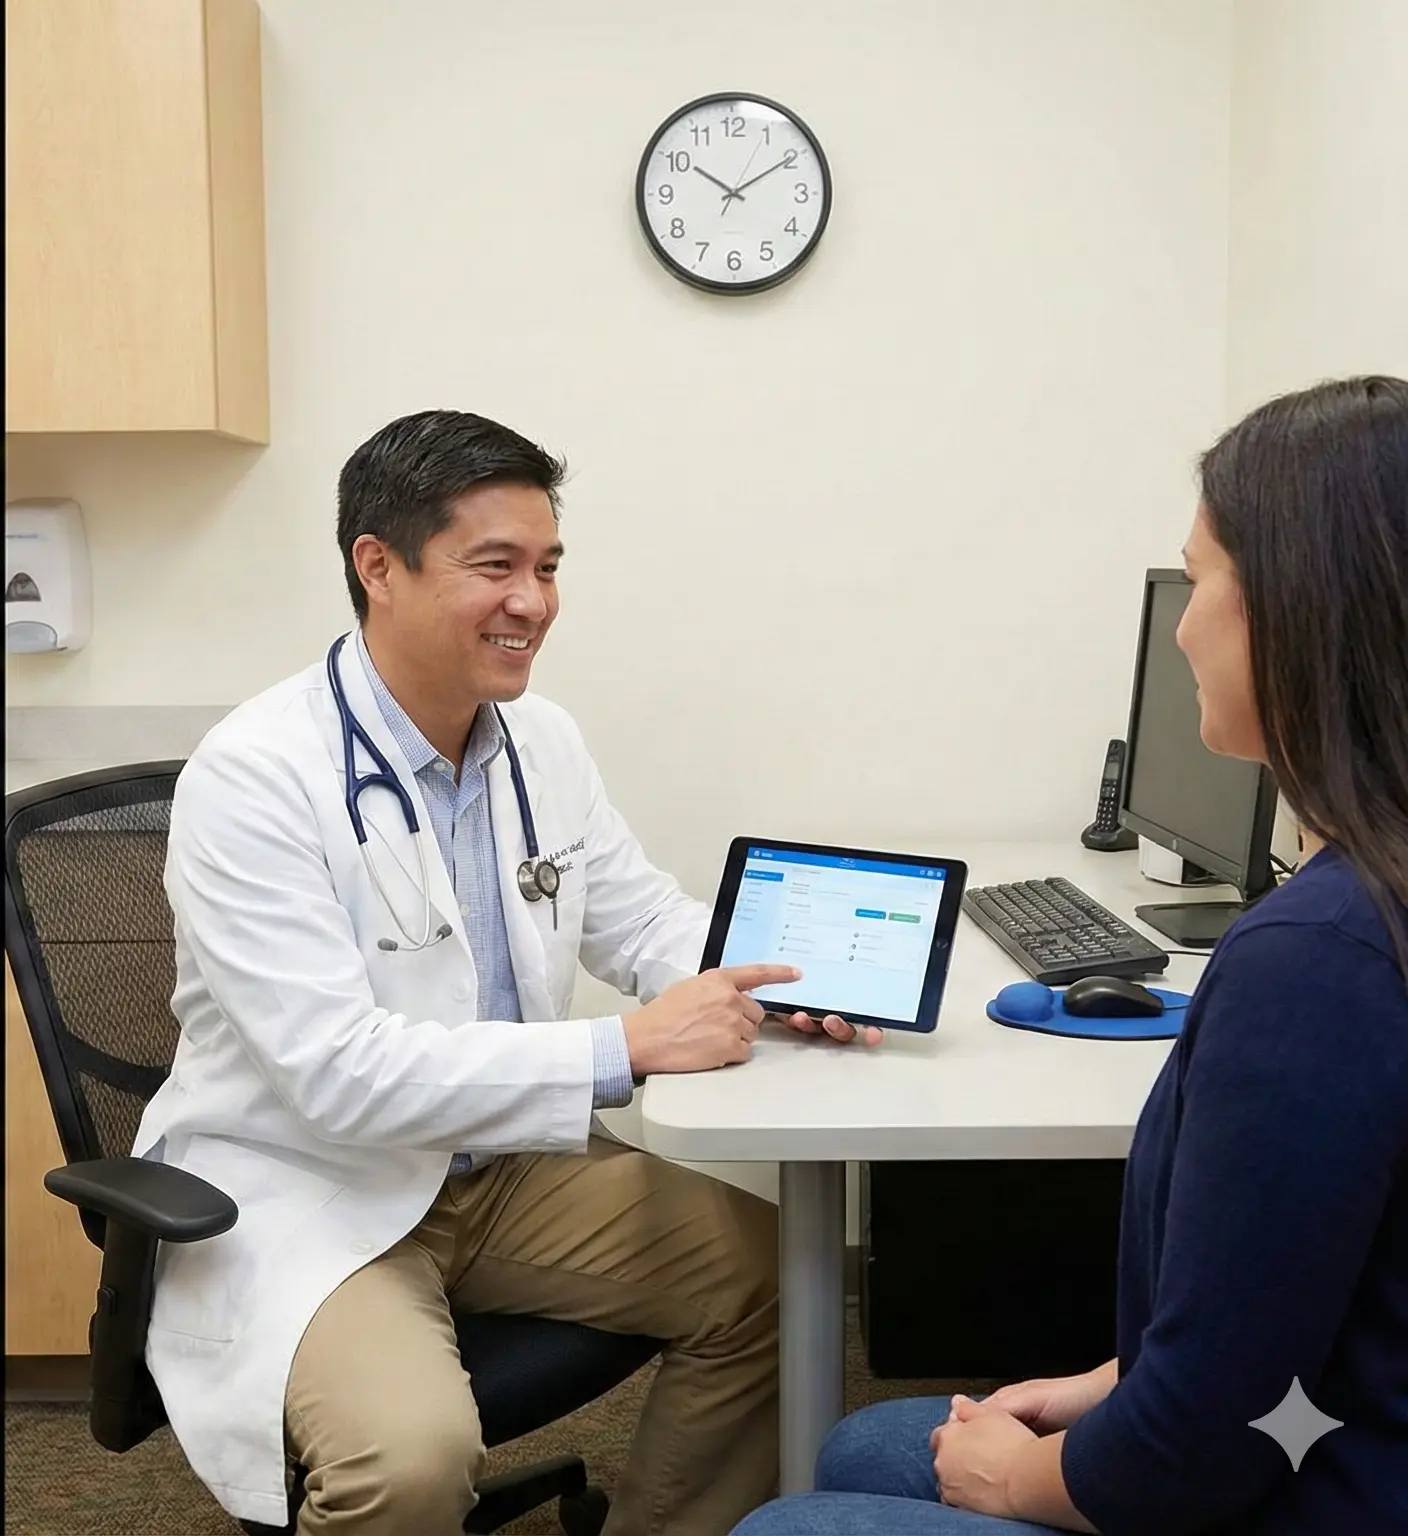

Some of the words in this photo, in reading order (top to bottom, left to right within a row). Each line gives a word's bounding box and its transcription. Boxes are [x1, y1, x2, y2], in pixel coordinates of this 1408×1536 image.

[690, 126, 710, 146] 11
[720, 116, 746, 137] 12
[762, 124, 770, 146] 1
[665, 151, 690, 172] 10
[783, 149, 798, 169] 2
[658, 184, 674, 205] 9
[794, 182, 809, 204] 3
[670, 217, 685, 239] 8
[784, 216, 799, 236] 4
[695, 242, 710, 262] 7
[726, 250, 742, 271] 6
[759, 241, 774, 261] 5
